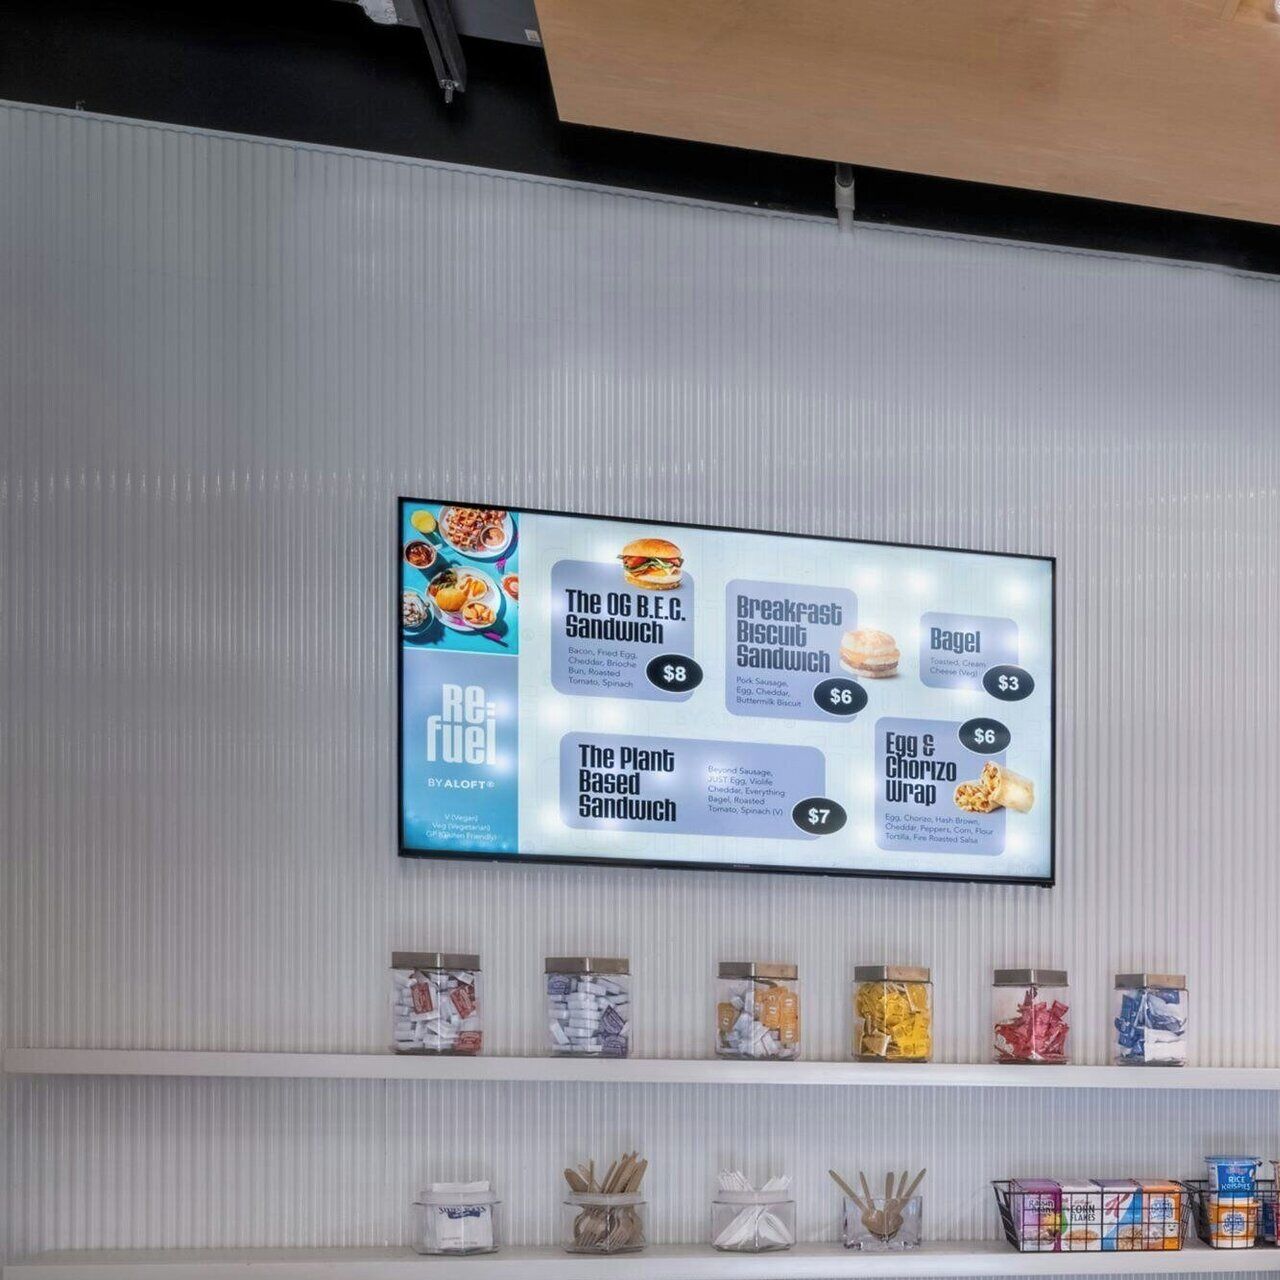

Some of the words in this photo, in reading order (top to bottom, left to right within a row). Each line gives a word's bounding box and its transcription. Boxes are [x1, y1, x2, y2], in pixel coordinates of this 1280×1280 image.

[565, 589, 601, 615] The
[606, 593, 631, 616] OG
[637, 595, 686, 621] B.E.C.
[737, 594, 842, 626] Breakfast
[566, 614, 664, 644] Sandwich
[737, 620, 807, 647] Biscuit
[930, 627, 981, 654] Bagel
[737, 644, 830, 673] Sandwich
[588, 668, 621, 677] Roasted
[602, 679, 633, 688] Spinach
[663, 664, 687, 683] $8
[998, 674, 1019, 692] $3
[442, 683, 497, 724] Re:
[829, 687, 853, 705] $6
[886, 732, 918, 758] Egg
[923, 734, 935, 757] &
[974, 727, 995, 745] $6
[579, 744, 615, 768] The
[620, 747, 675, 773] Plant
[886, 755, 957, 782] Chorizo
[427, 778, 442, 787] BY
[579, 769, 640, 796] Based
[886, 780, 936, 806] Wrap
[579, 794, 677, 822] Sandwich
[808, 807, 830, 825] $7
[1222, 1183, 1251, 1191] KRISPIES
